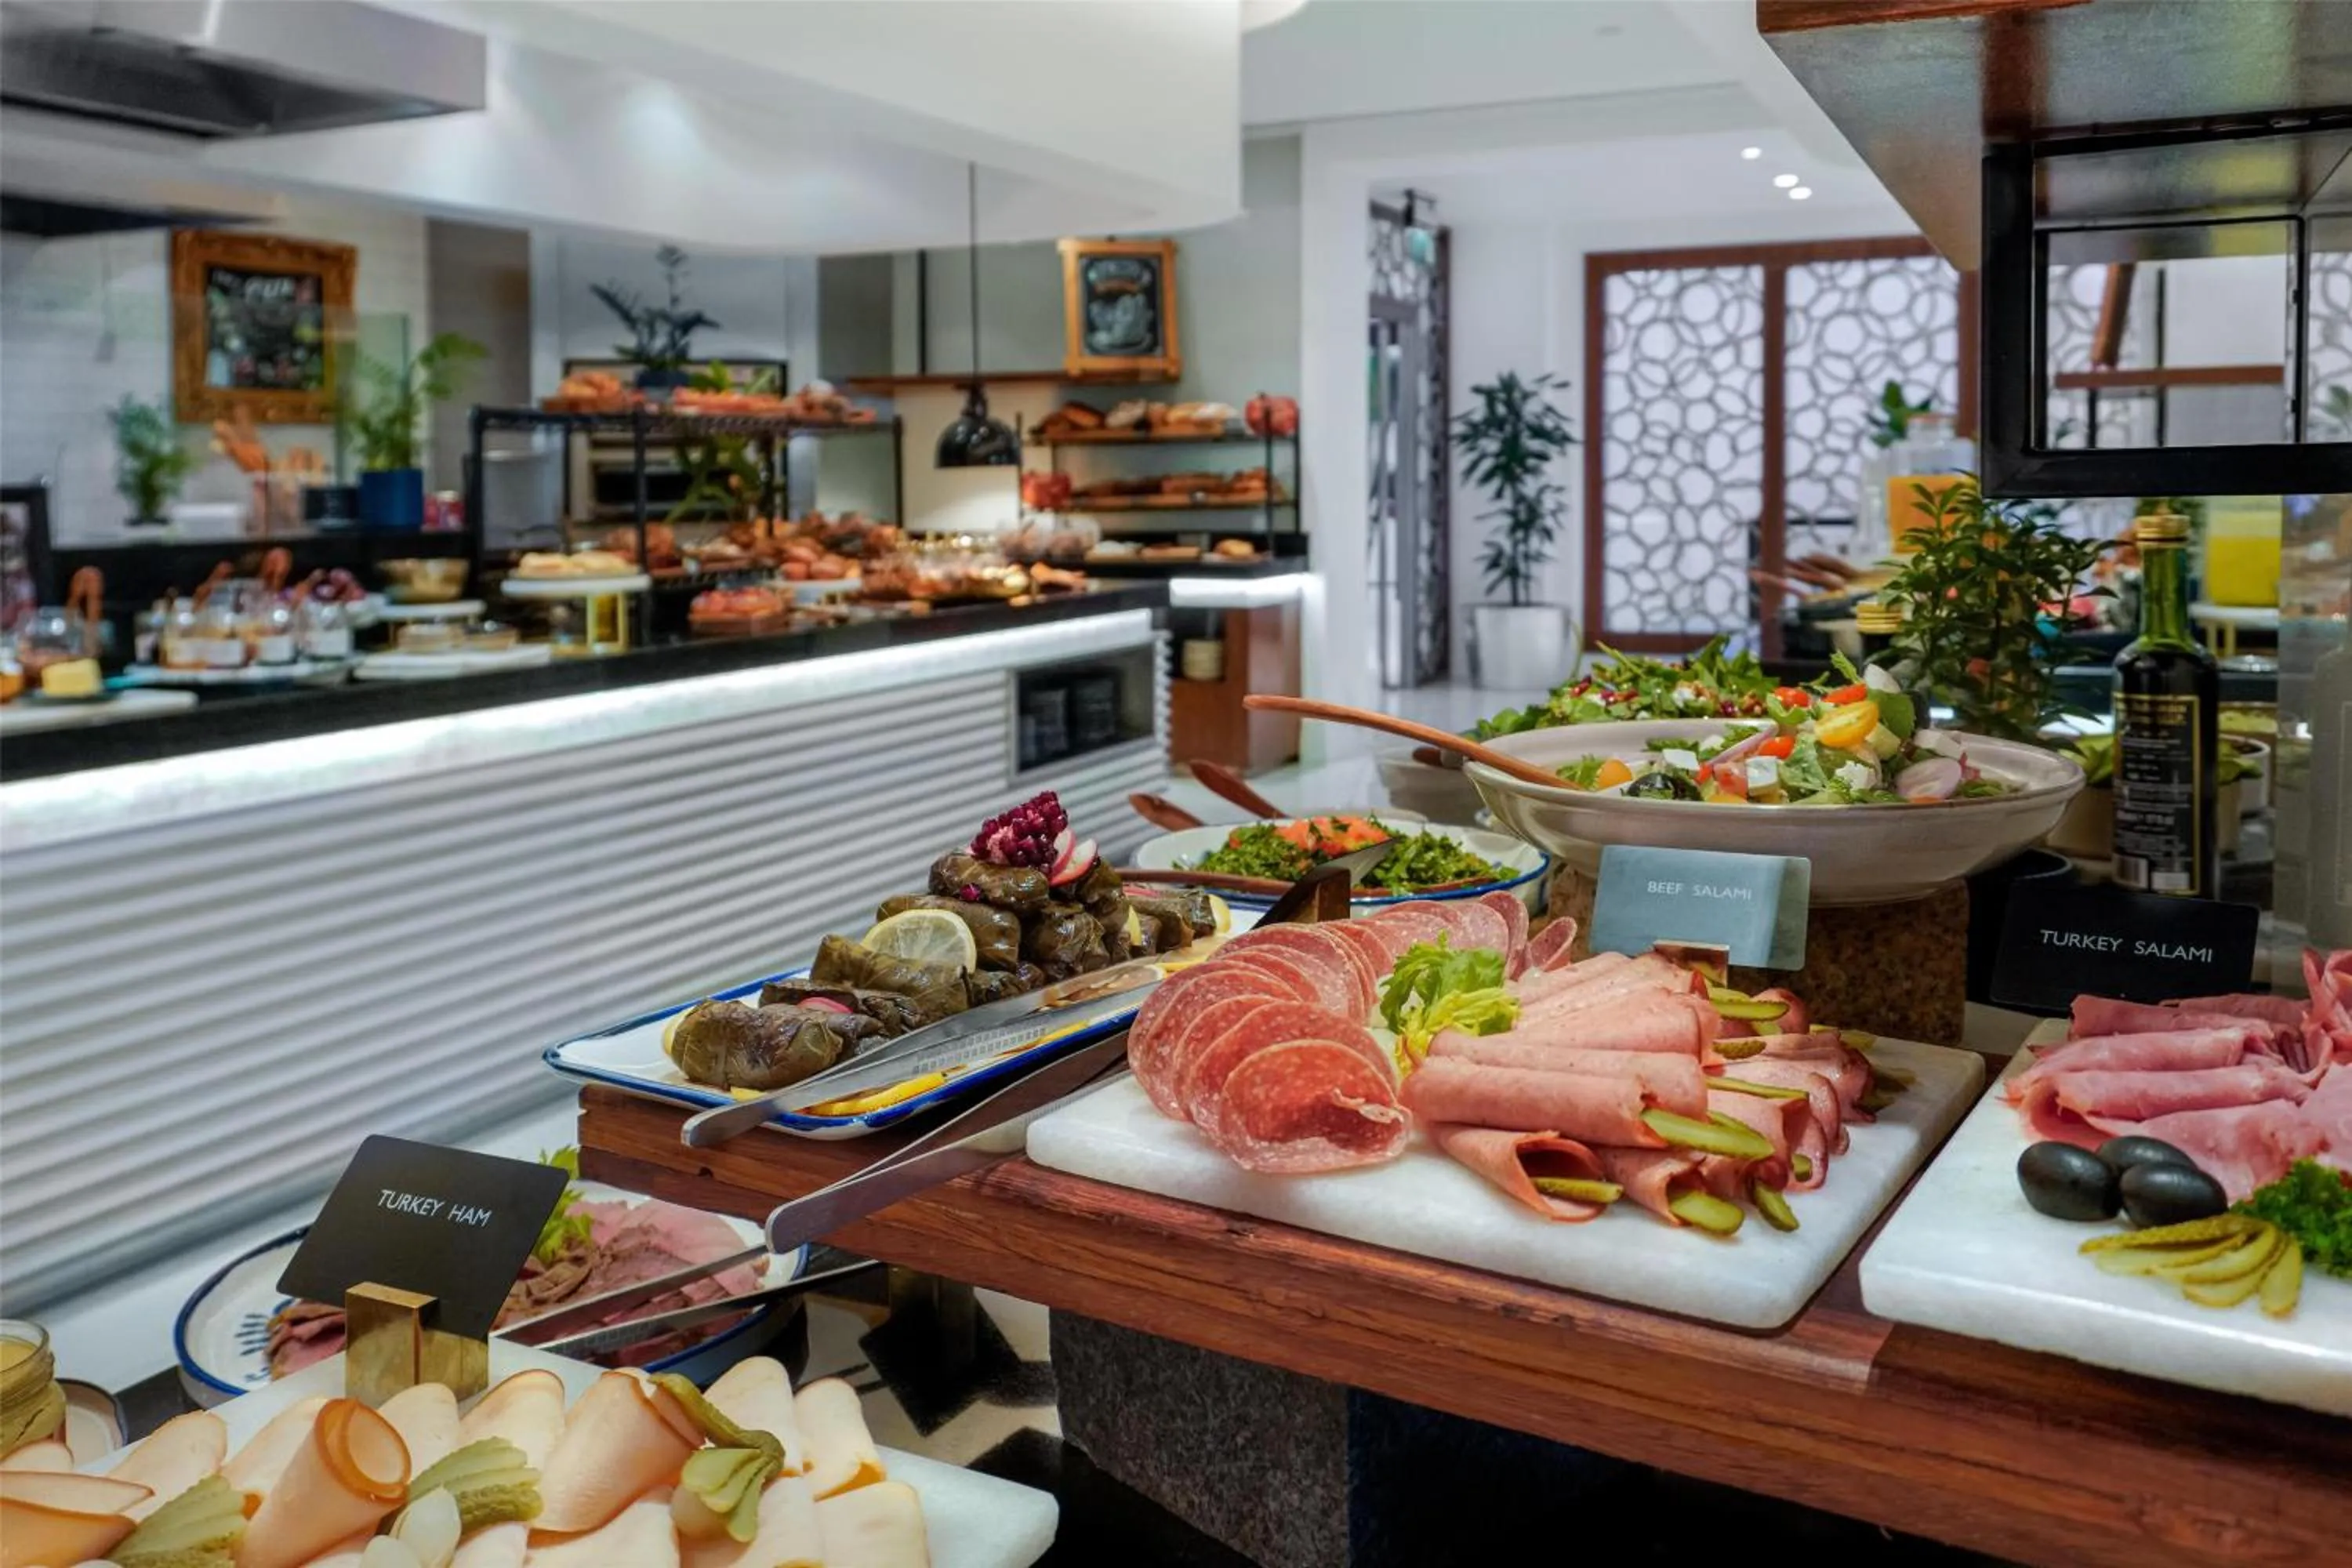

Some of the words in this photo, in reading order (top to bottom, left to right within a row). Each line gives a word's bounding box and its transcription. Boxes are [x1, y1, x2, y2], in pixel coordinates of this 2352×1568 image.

[1647, 880, 1684, 895] BEEF
[1692, 885, 1752, 901] SALAMI
[2040, 929, 2124, 953] TURKEY
[2133, 941, 2213, 964] SALAMI
[377, 1189, 445, 1217] TURKEY
[448, 1203, 492, 1227] HAM
